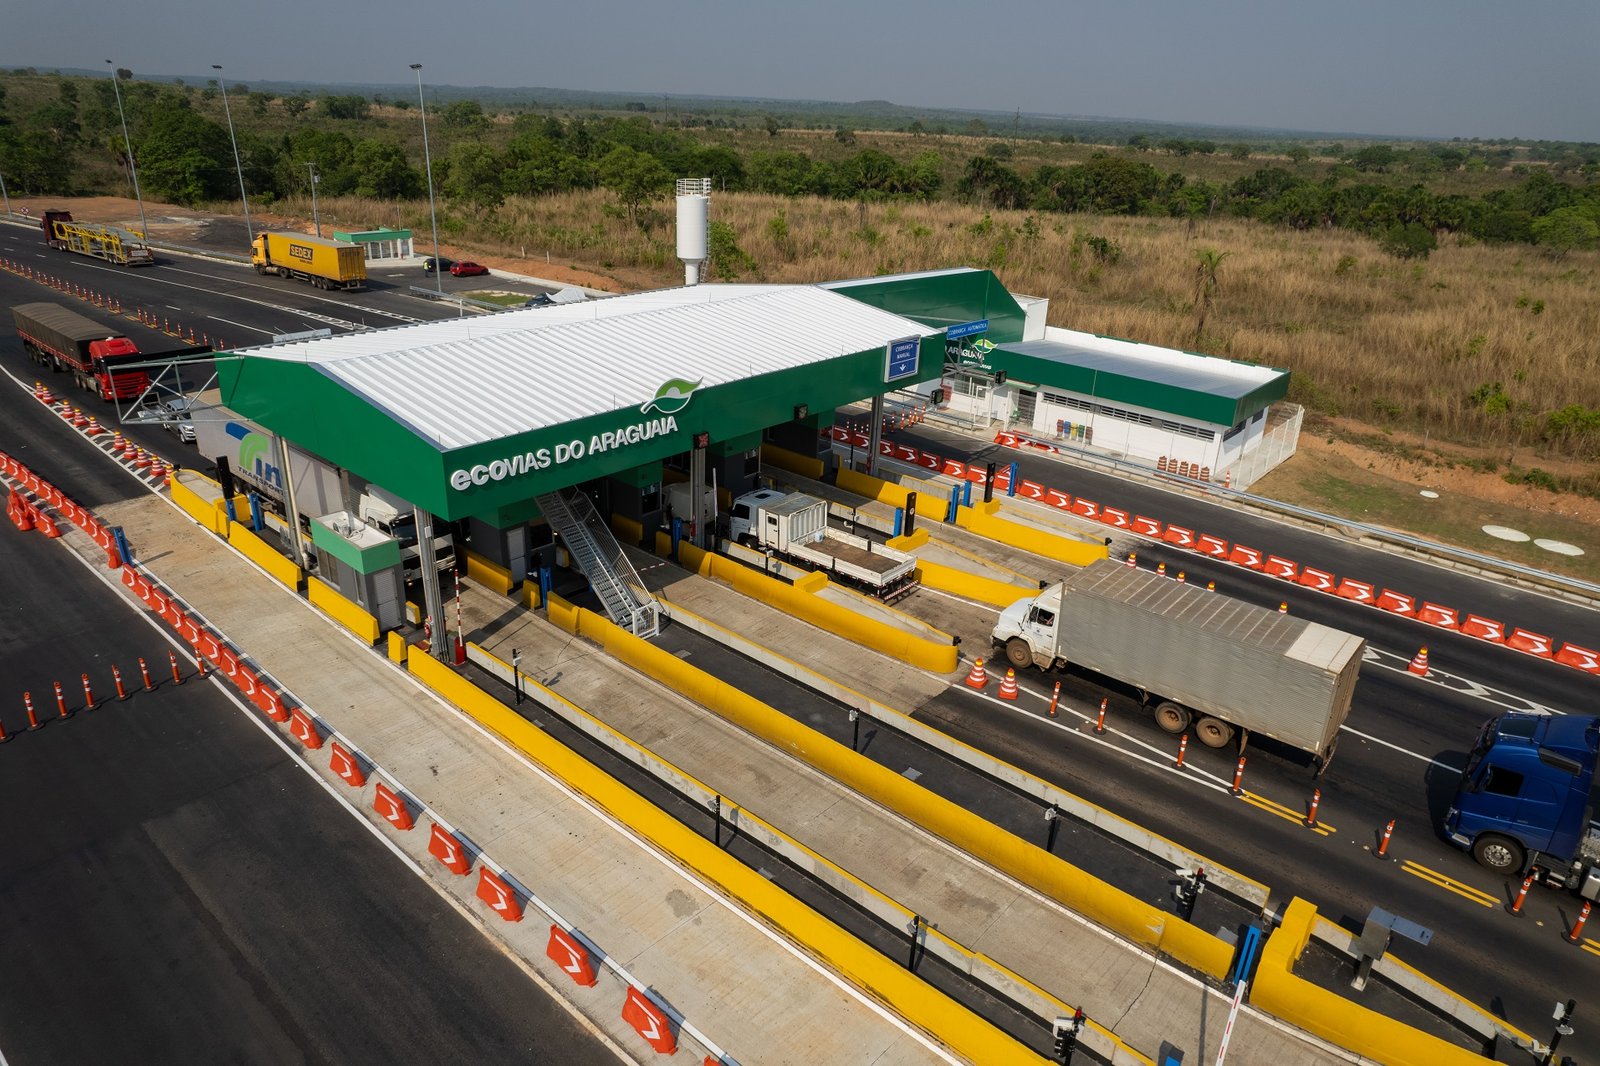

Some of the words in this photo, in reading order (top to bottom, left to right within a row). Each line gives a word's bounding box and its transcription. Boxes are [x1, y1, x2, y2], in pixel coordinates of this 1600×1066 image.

[290, 246, 312, 259] SEDEX
[555, 440, 585, 464] DO
[589, 416, 678, 455] ARAGUAIA
